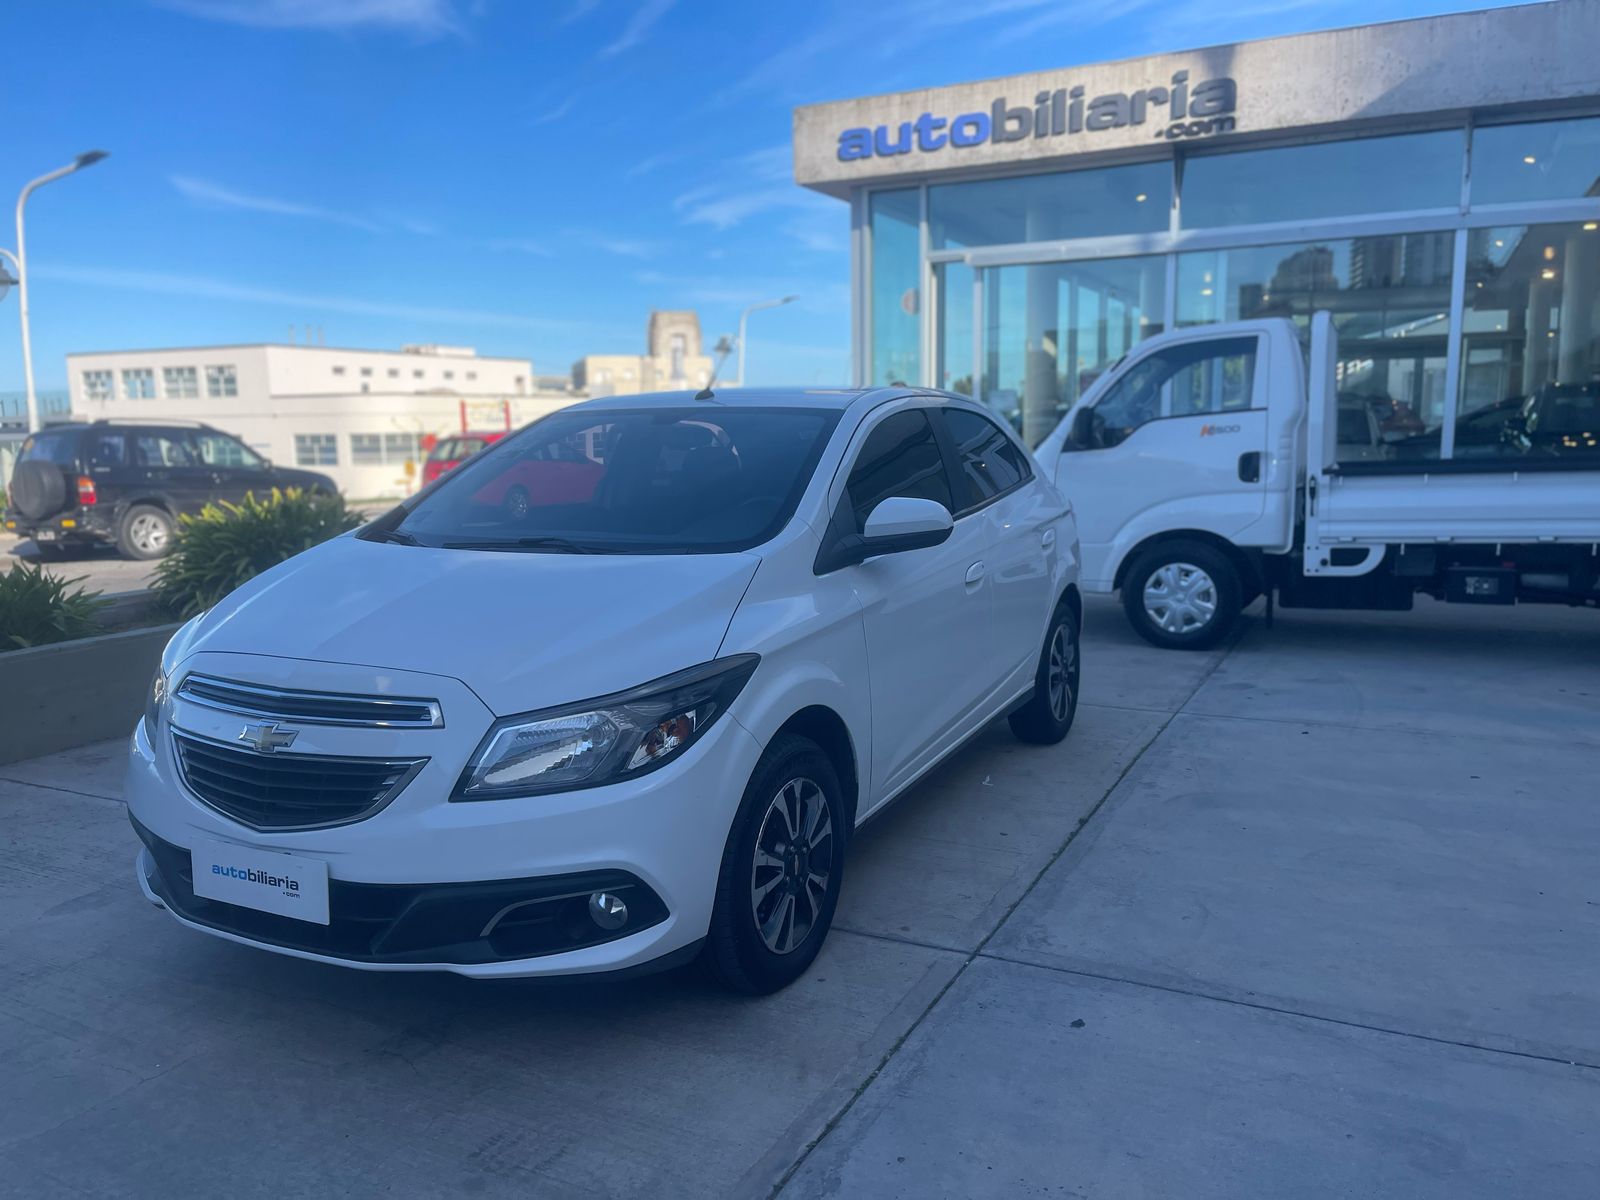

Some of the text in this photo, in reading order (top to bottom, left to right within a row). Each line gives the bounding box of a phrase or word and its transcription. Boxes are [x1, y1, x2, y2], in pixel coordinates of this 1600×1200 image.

[837, 70, 1237, 162] autobiliaria
[1154, 114, 1236, 139] .com
[212, 864, 299, 891] autobiliaria
[282, 890, 301, 899] .com
